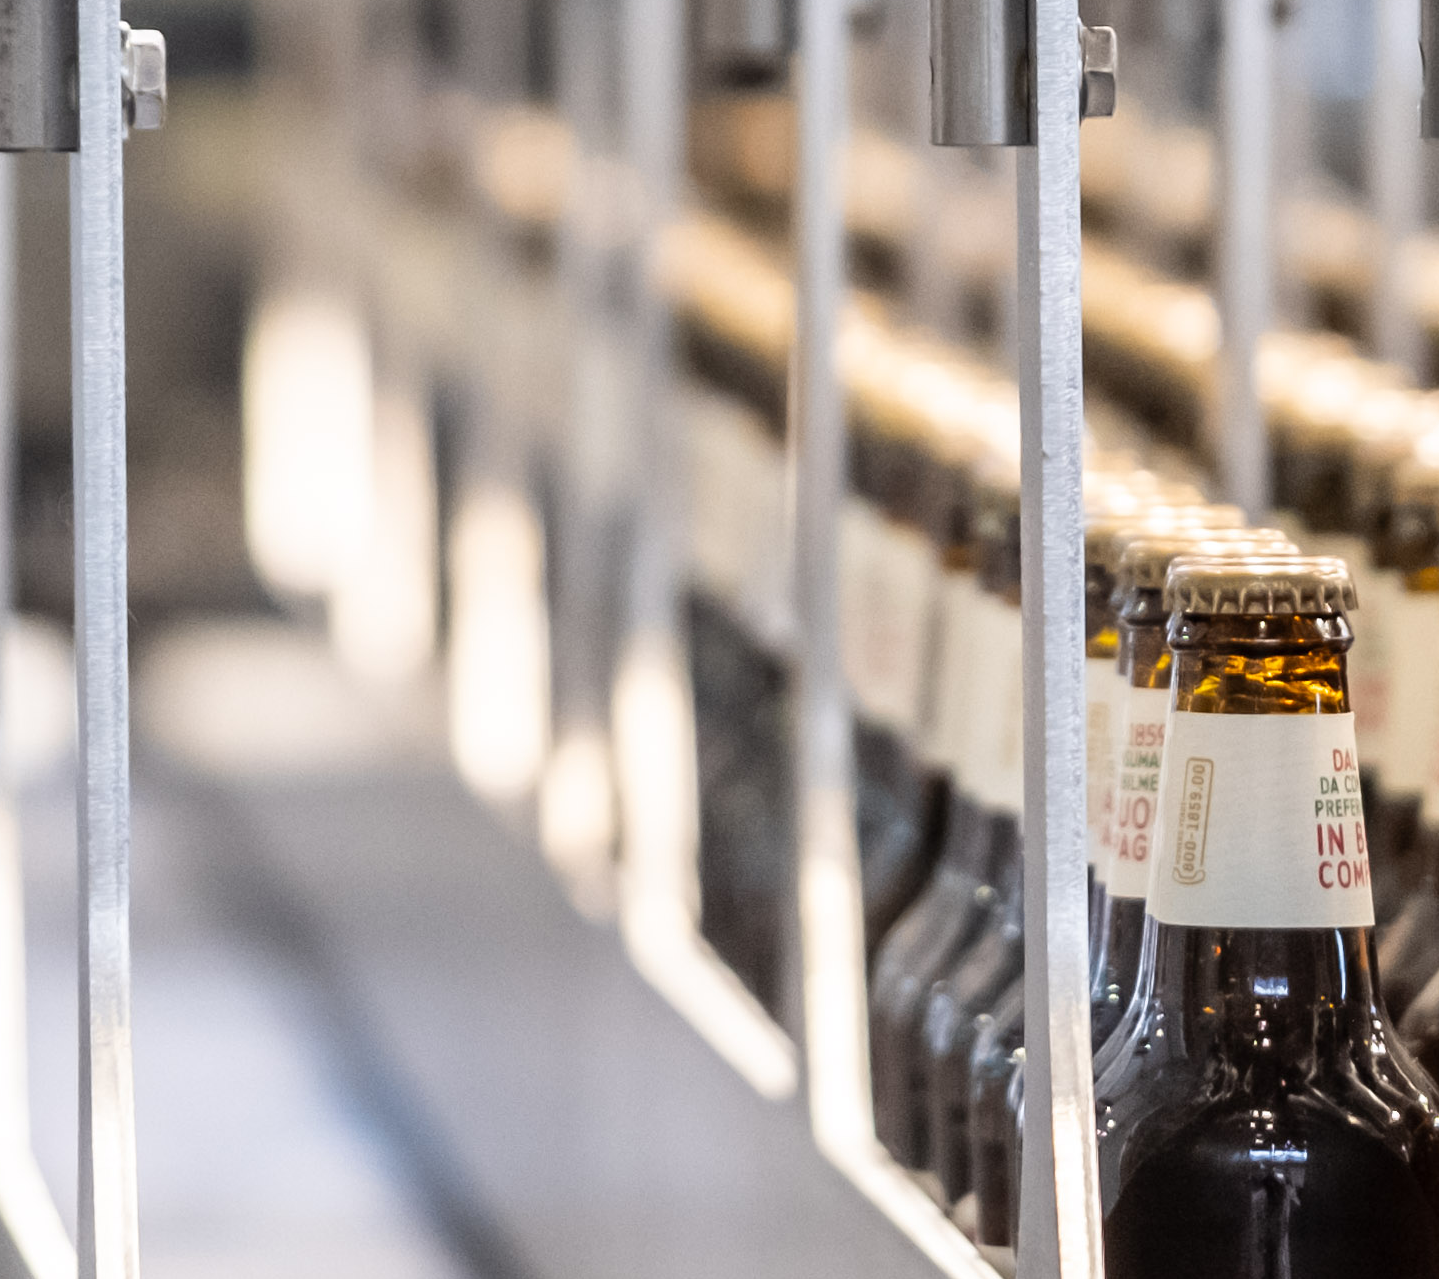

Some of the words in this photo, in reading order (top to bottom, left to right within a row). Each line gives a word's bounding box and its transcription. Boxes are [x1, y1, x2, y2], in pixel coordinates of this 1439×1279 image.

[1319, 776, 1340, 795] DA
[1182, 763, 1206, 873] 800-1859.00
[1316, 822, 1346, 857] IN
